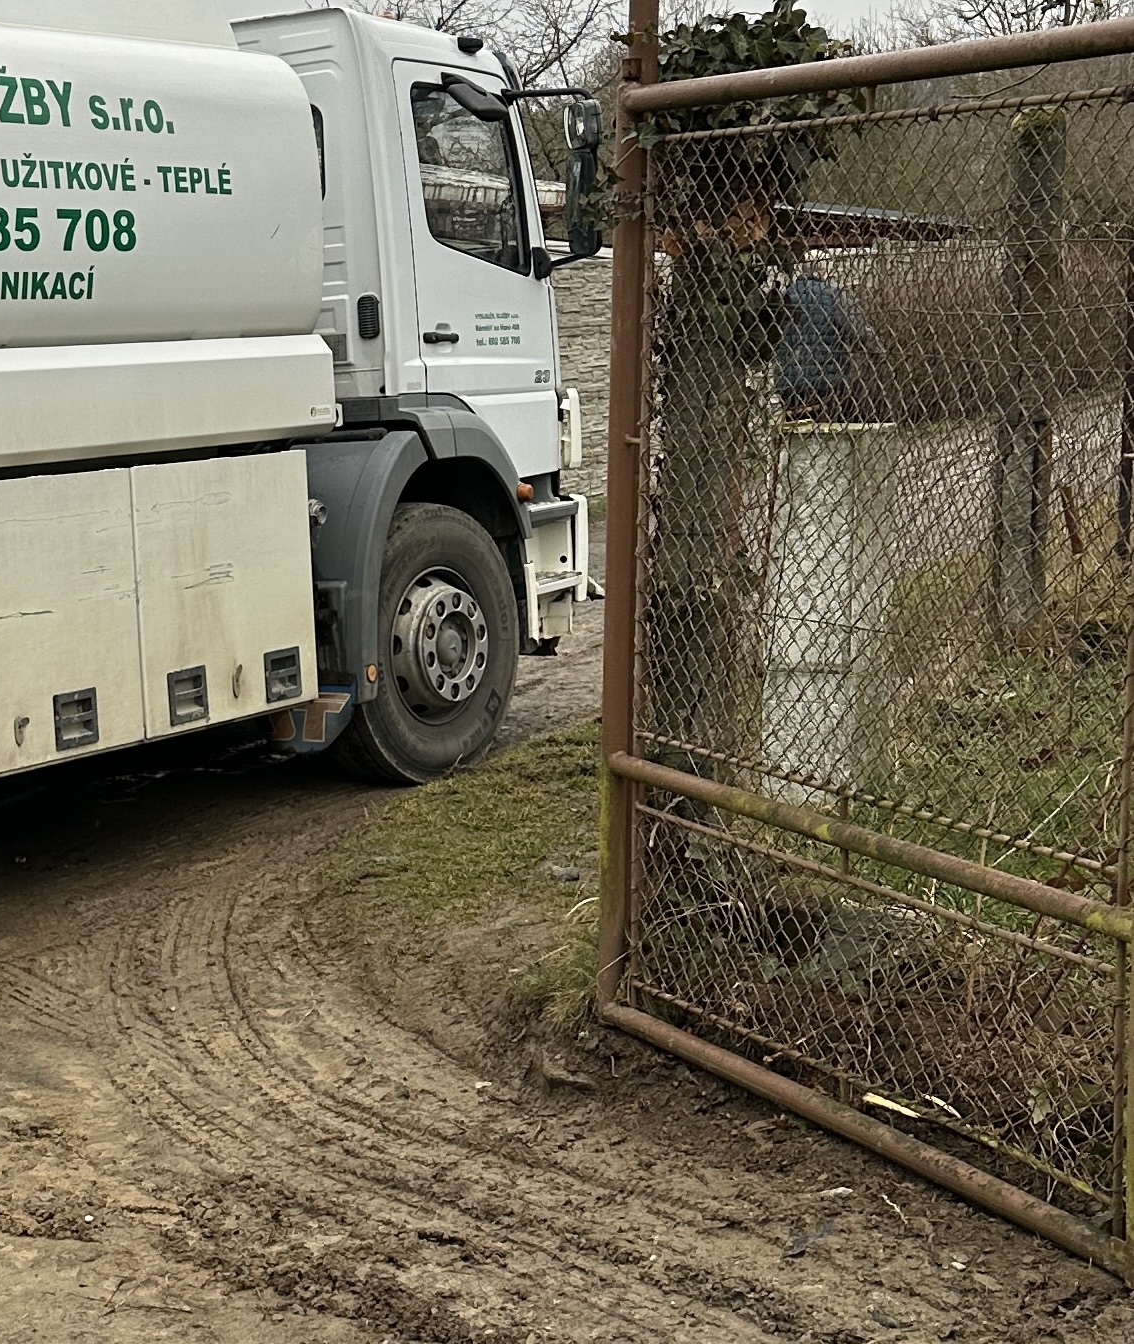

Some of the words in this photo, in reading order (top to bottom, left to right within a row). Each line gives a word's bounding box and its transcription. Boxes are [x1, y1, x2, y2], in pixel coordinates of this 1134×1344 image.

[88, 94, 176, 134] s.r.o.
[0, 152, 136, 192] UŽITKOVÉ
[157, 162, 233, 196] TEPLÉ
[56, 207, 138, 253] 708
